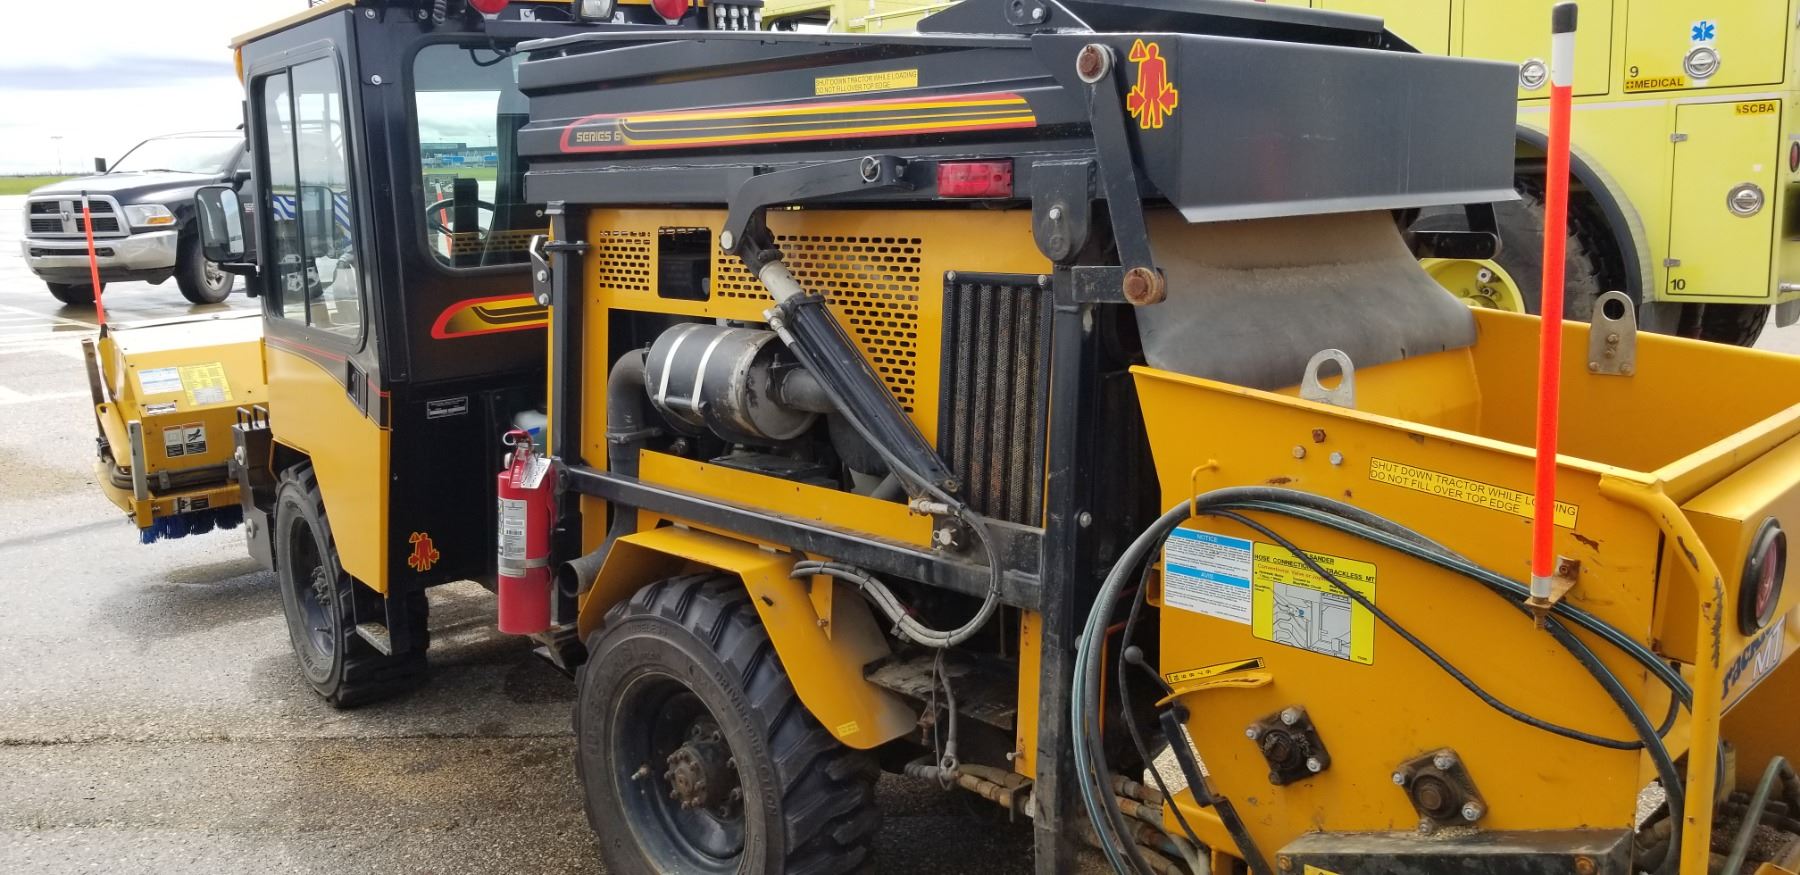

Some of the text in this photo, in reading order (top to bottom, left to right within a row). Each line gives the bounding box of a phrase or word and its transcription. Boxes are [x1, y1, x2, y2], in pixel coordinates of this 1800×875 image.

[1629, 65, 1639, 78] 9
[829, 77, 847, 86] DOWN
[848, 75, 872, 84] TRACTOR
[873, 73, 891, 82] WHILE
[892, 70, 917, 79] LOADING
[1634, 78, 1684, 89] MEDICAL
[847, 84, 862, 92] OVER
[1742, 103, 1775, 114] SCBA
[576, 130, 621, 142] SERIES 6
[1670, 278, 1686, 290] 10
[1371, 460, 1576, 516] SHUT DOWN TRACTOR WHILE LING
[1371, 469, 1521, 514] DO NOT FILL OVER TOP EDGE
[1196, 533, 1218, 543] NOTICE
[1254, 554, 1270, 563] HOSE
[1326, 567, 1363, 581] TRACKLESS
